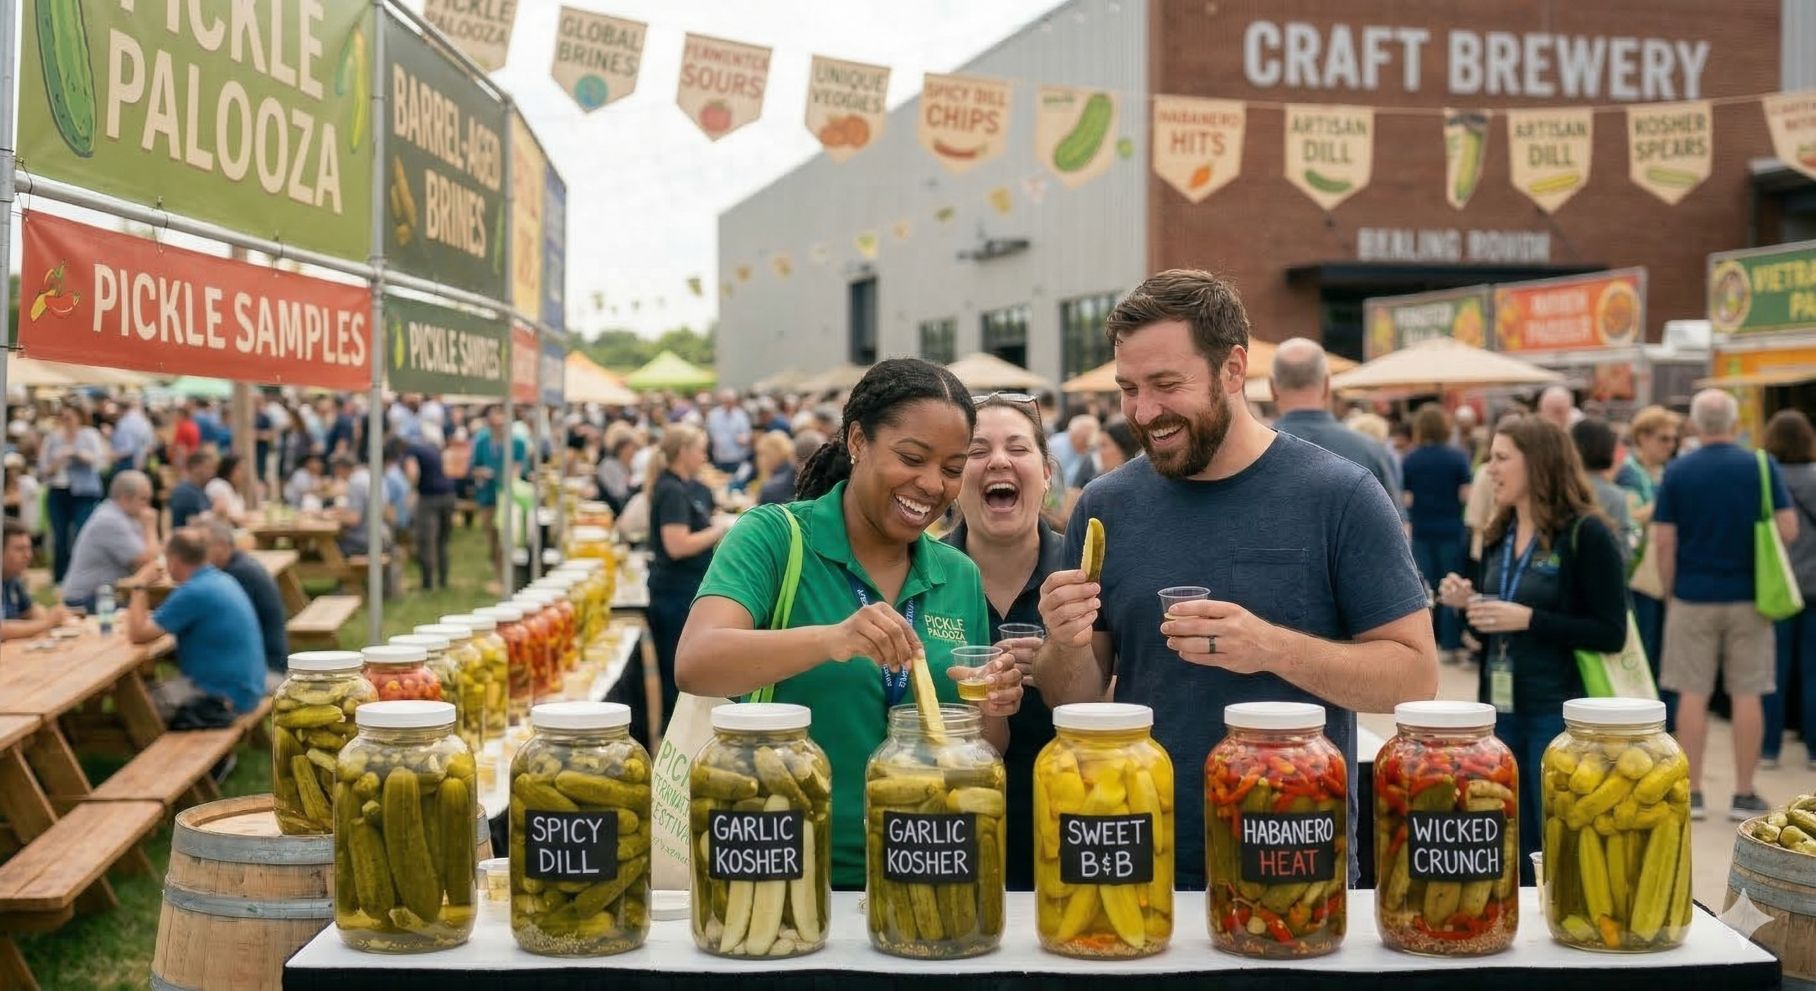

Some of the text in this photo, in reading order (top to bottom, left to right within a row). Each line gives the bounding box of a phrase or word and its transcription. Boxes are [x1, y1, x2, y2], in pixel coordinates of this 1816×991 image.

[560, 15, 641, 47] GLOBAL
[557, 42, 636, 79] BRINES
[1243, 21, 1711, 101] CRAFT BREWERY
[681, 63, 763, 100] SOURS
[815, 62, 885, 93] UNIQUE
[106, 28, 343, 215] PALOOZA
[393, 63, 501, 192] BARREL-AGED
[926, 104, 1001, 134] CHIPS
[1291, 115, 1368, 137] ARTISAN
[1514, 119, 1587, 139] ARTISAN
[1635, 113, 1707, 135] KOSHER
[1170, 131, 1226, 157] HITS
[1303, 139, 1353, 165] DILL
[1528, 143, 1575, 168] DILL
[1634, 136, 1707, 162] SPEARS
[425, 168, 486, 259] BRINES
[93, 263, 366, 367] PICKLE SAMPLES
[408, 321, 458, 376] PICKLE
[924, 614, 966, 631] PICKLE
[927, 627, 966, 641] PALOOZA
[532, 815, 604, 843] SPICY
[713, 815, 794, 842] GARLIC
[889, 818, 967, 844] GARLIC
[1067, 818, 1146, 846] SWEET
[1244, 818, 1334, 845] HABANERO
[1412, 816, 1499, 843] WICKED
[539, 848, 600, 874] DILL
[716, 847, 799, 875] KOSHER
[887, 848, 969, 875] KOSHER
[1260, 849, 1320, 876] HEAT
[1413, 847, 1500, 874] CRUNCH
